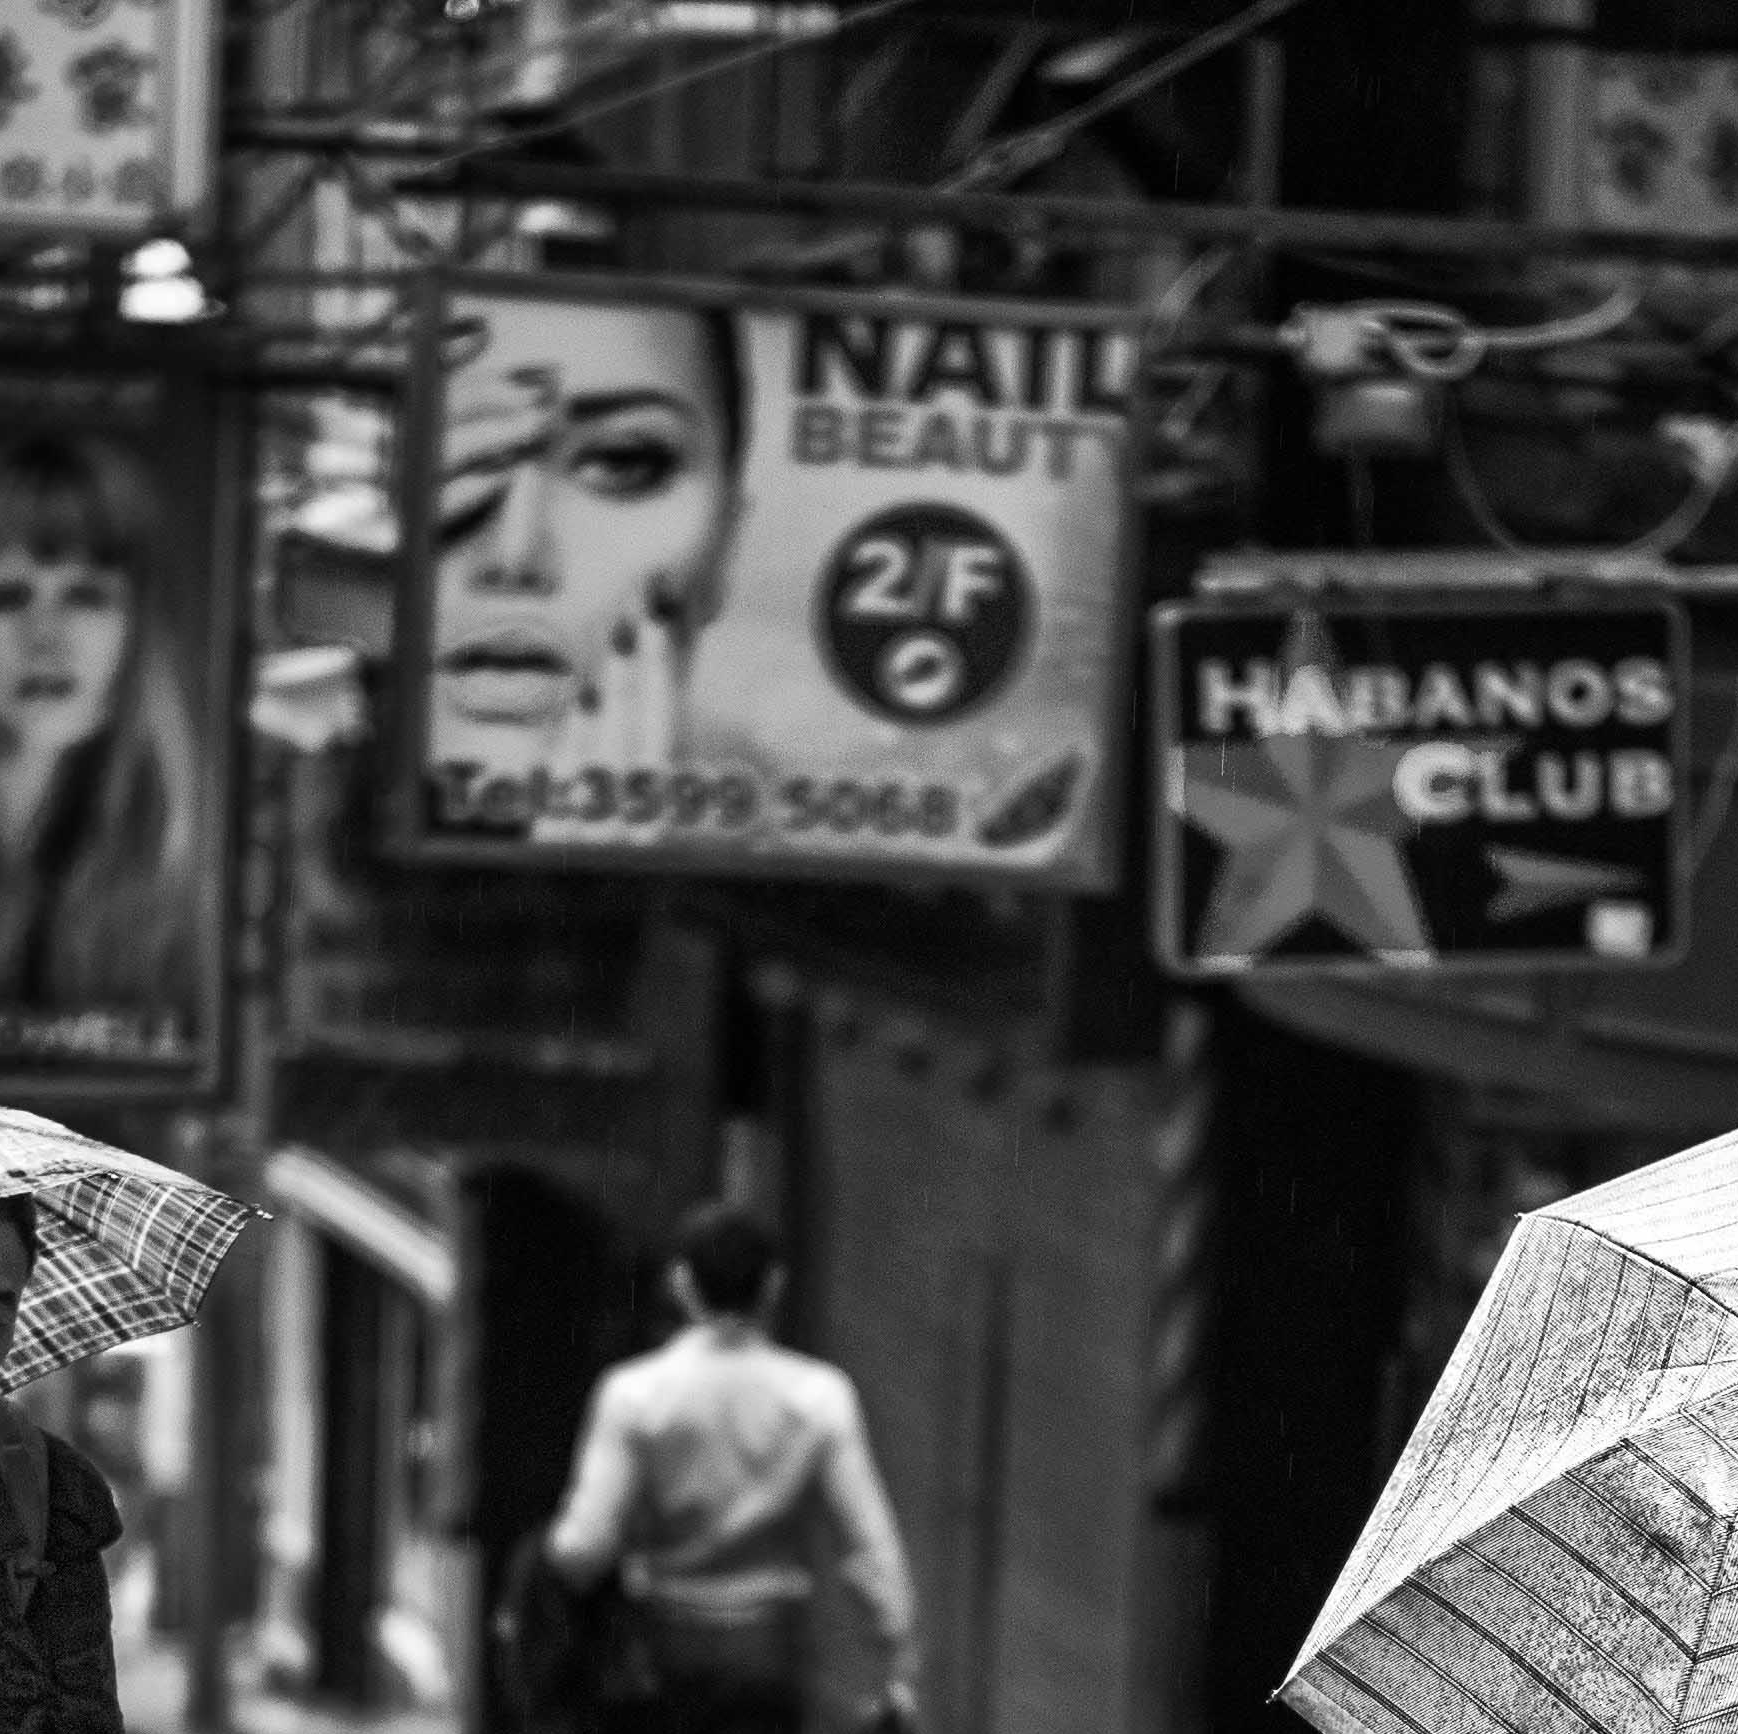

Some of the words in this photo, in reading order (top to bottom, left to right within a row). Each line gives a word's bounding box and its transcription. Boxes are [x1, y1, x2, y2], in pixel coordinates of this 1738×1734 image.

[799, 312, 1127, 410] NAIL
[1199, 654, 1673, 738] HABANOS
[1393, 740, 1673, 822] CLUB
